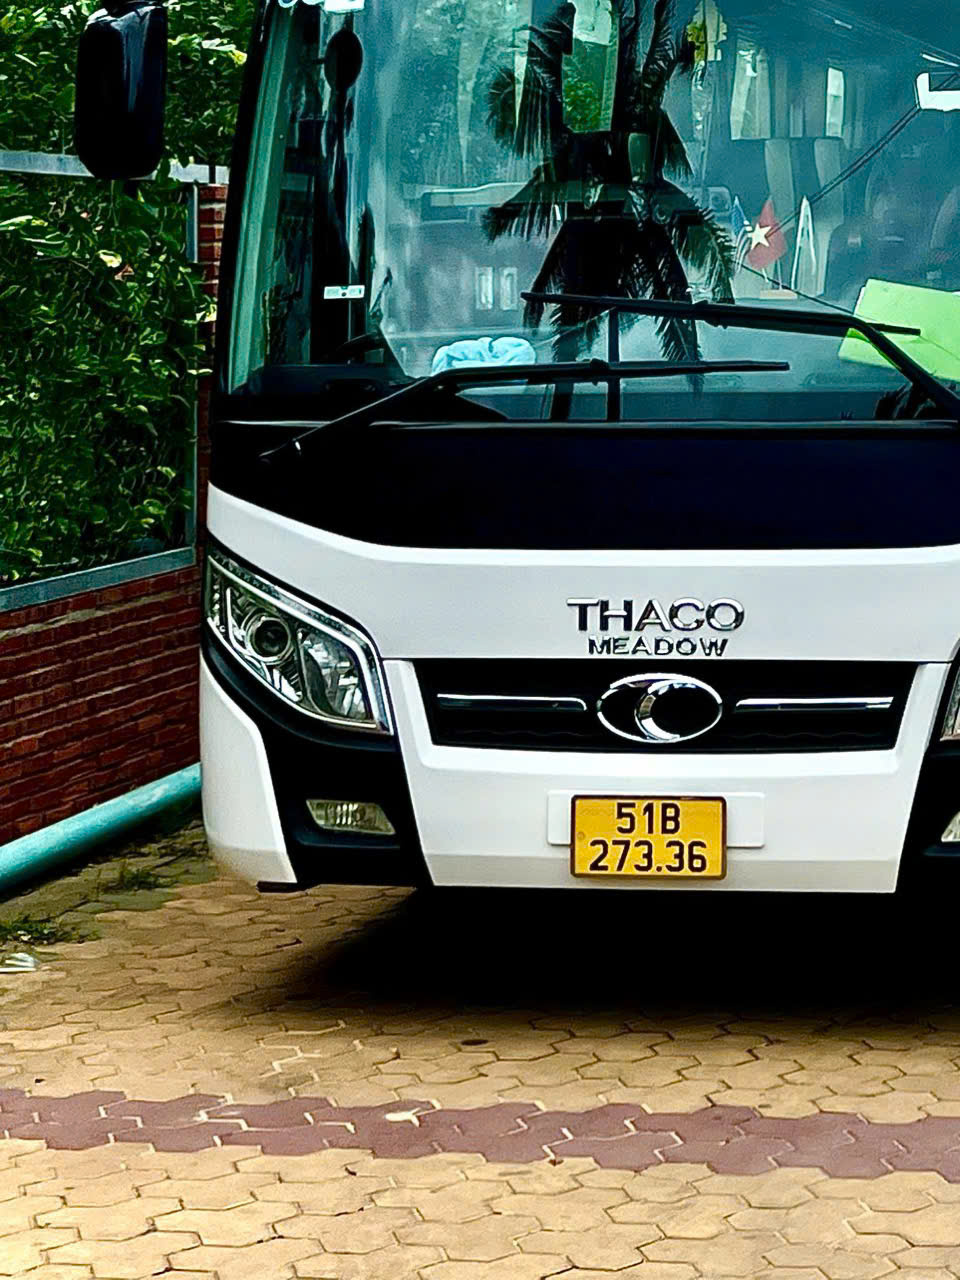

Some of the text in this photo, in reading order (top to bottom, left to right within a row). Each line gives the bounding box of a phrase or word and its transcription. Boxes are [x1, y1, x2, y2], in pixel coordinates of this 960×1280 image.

[566, 597, 745, 632] THACO
[587, 636, 728, 657] MEADOW
[616, 802, 681, 835] 51B
[589, 839, 707, 872] 273.36
